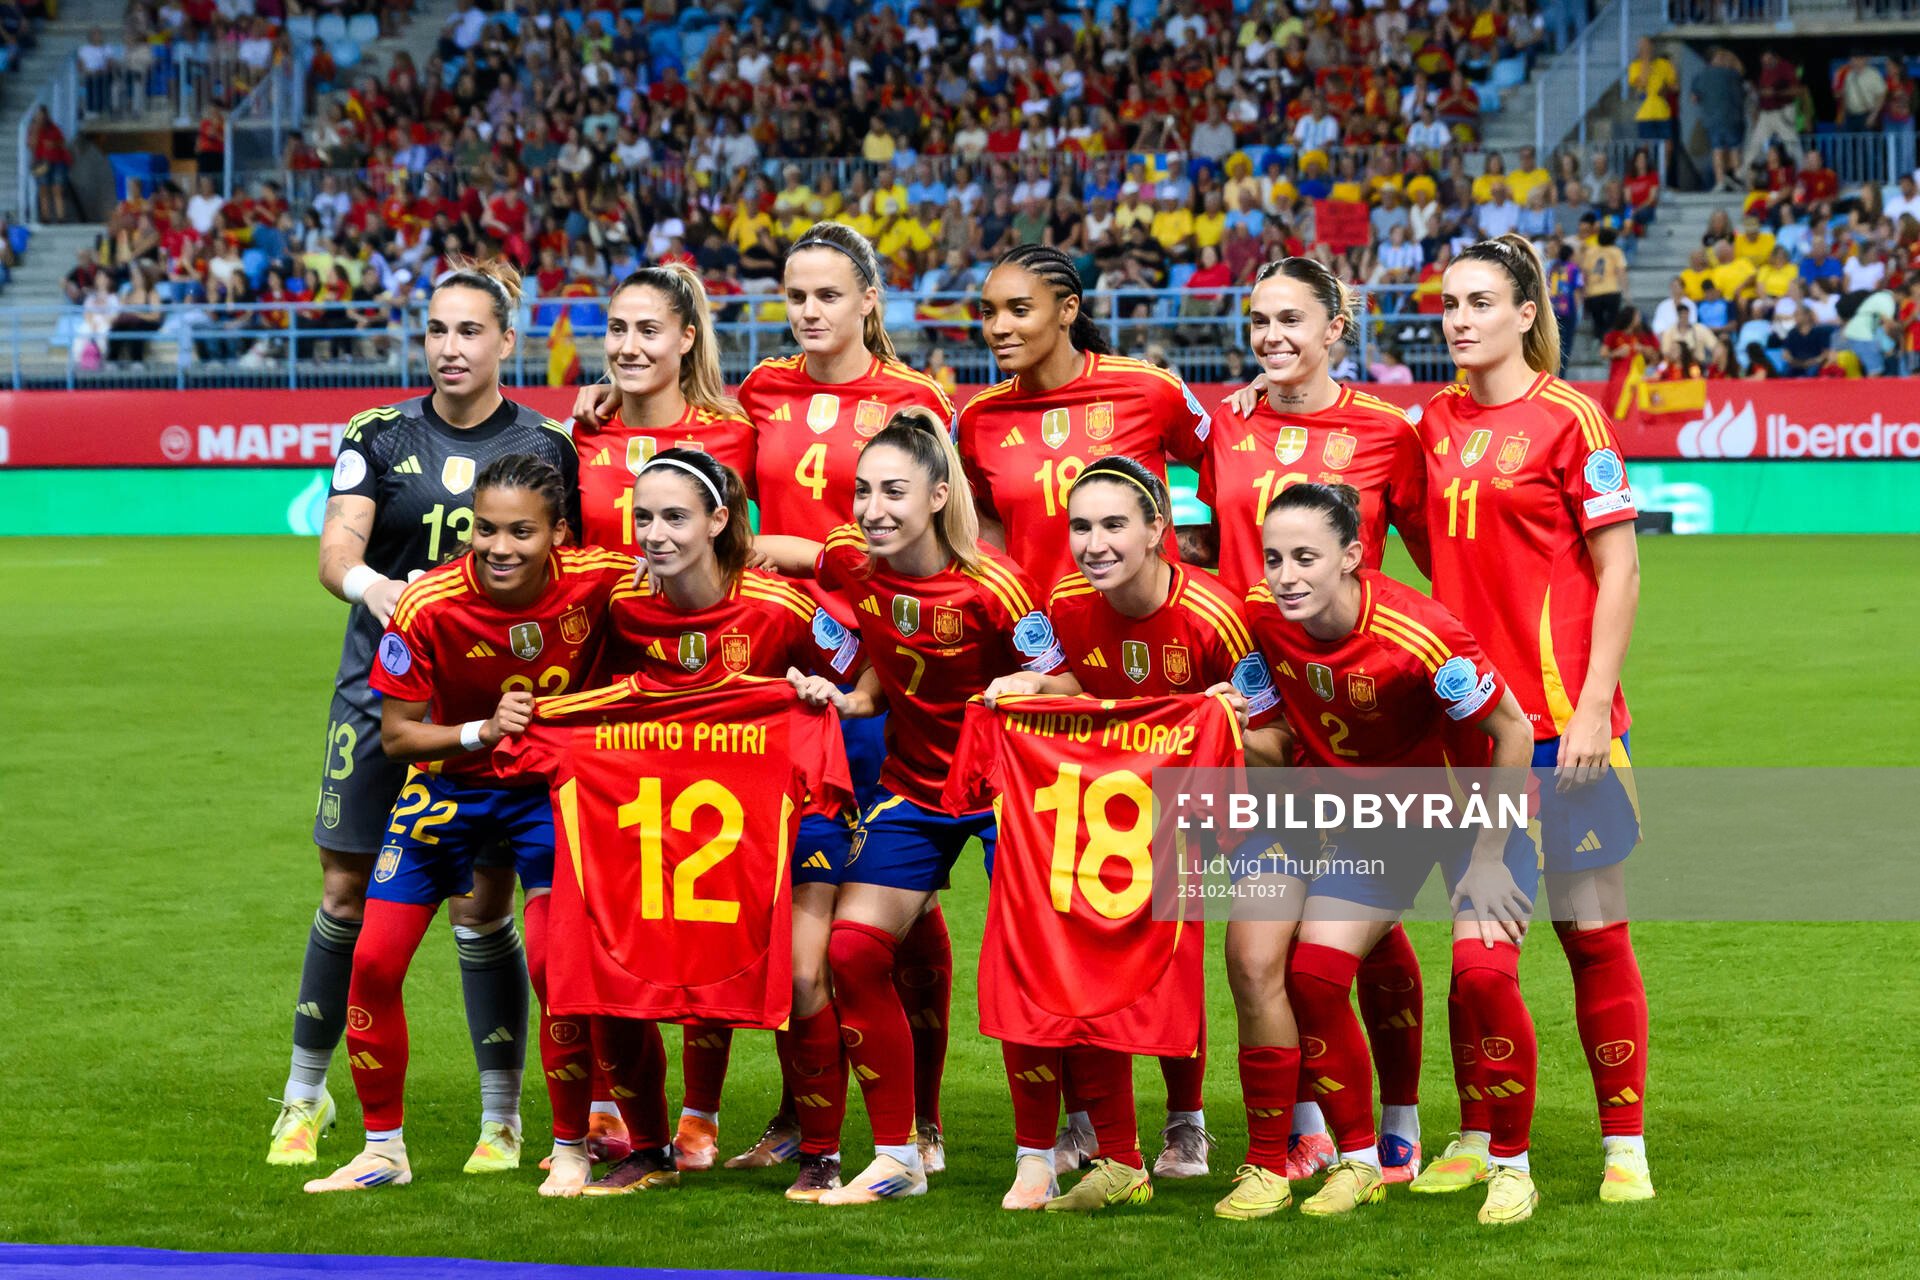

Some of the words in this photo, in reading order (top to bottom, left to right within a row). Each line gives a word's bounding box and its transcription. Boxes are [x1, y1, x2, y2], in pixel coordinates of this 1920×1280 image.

[795, 442, 828, 500] 4
[422, 503, 475, 561] 13
[613, 487, 634, 545] 1
[1443, 477, 1480, 540] 11
[895, 644, 926, 696] 7
[325, 720, 357, 780] 13
[694, 721, 766, 755] PATRI
[1320, 711, 1360, 757] 2
[388, 783, 458, 845] 22
[1033, 762, 1162, 920] 18
[617, 777, 745, 924] 12
